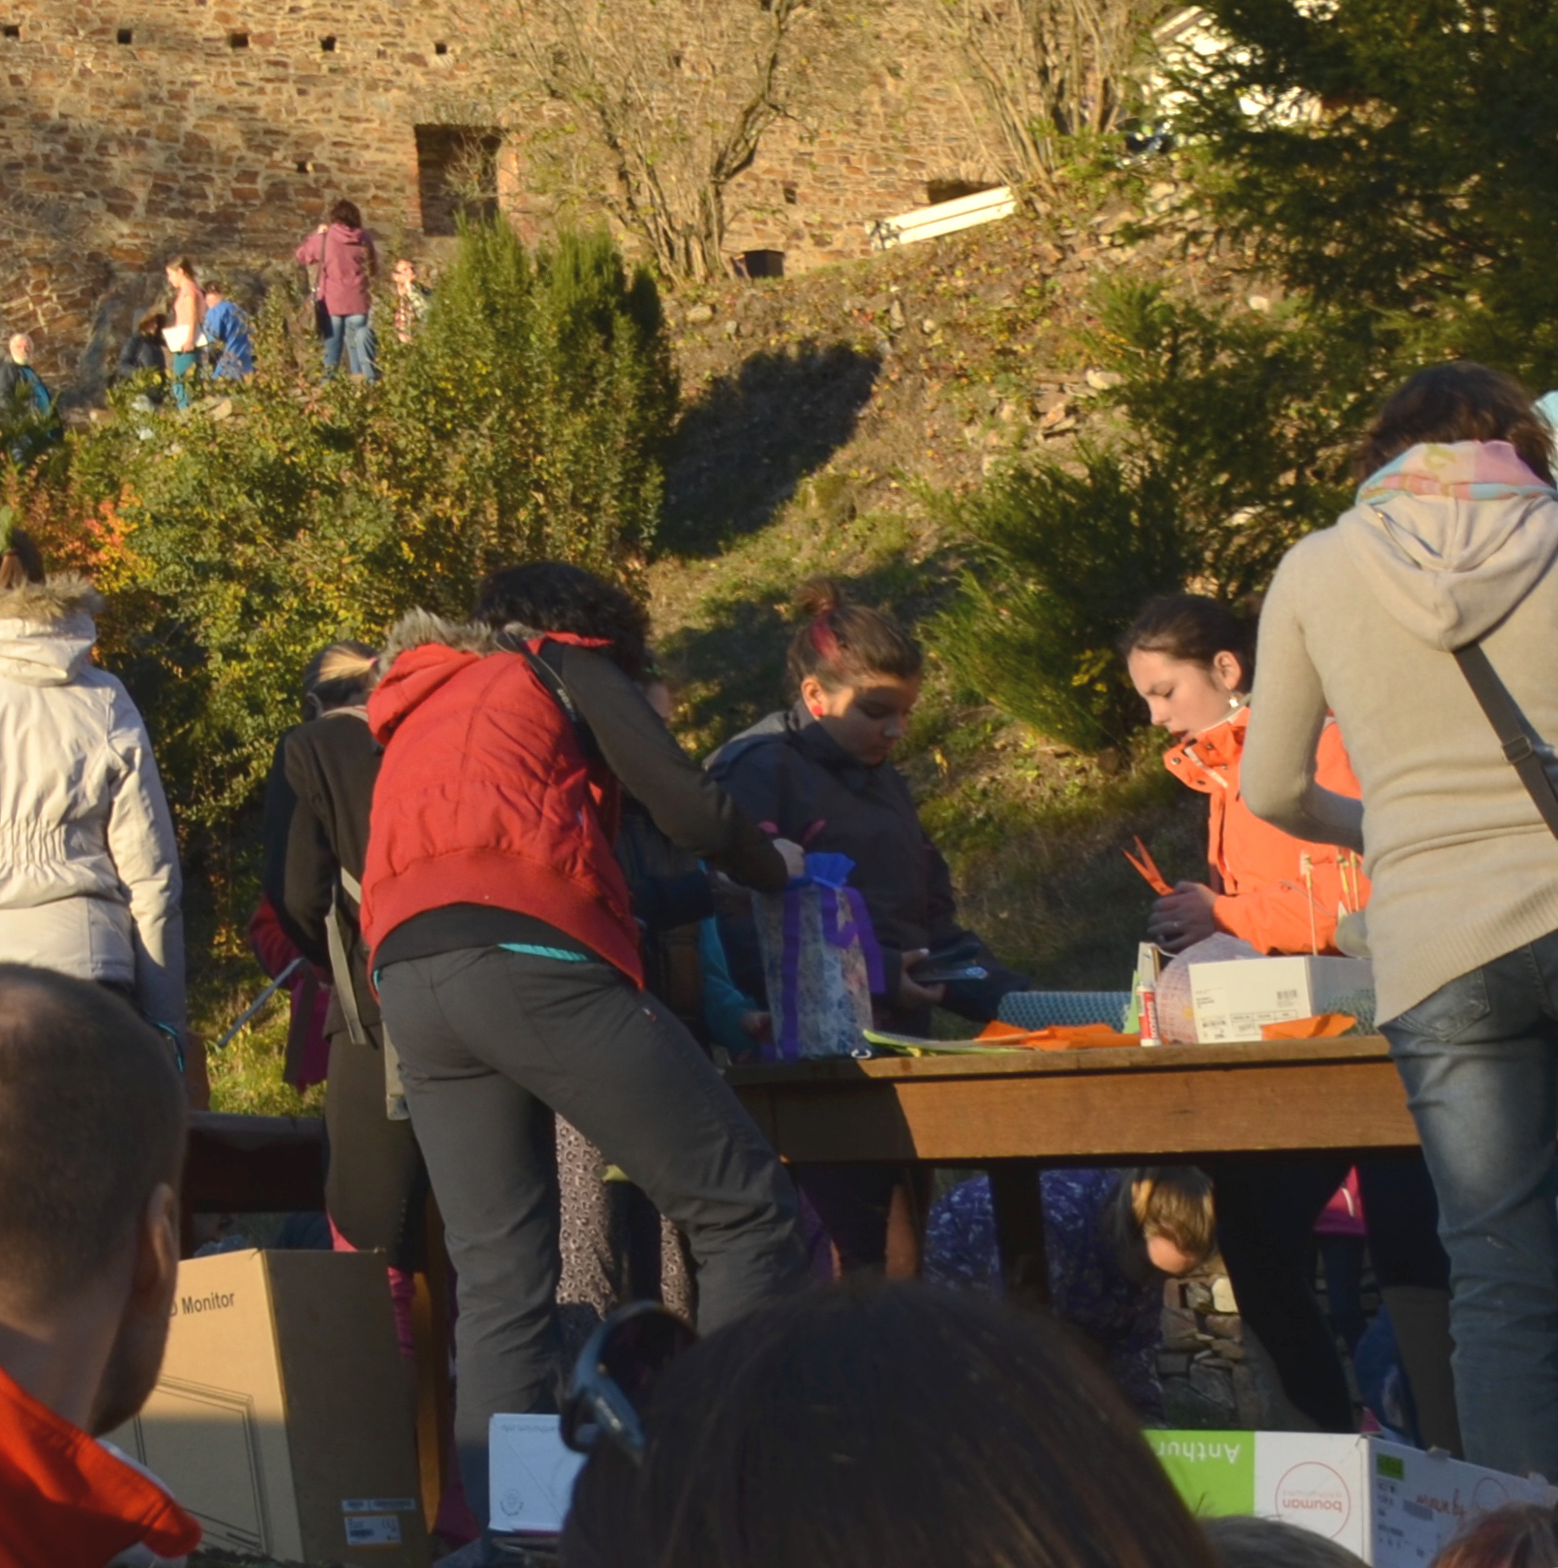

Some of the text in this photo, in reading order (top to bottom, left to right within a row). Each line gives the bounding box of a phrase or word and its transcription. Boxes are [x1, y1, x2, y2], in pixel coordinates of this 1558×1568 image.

[181, 1292, 234, 1314] Monitor
[1157, 1441, 1241, 1465] Anthur
[1282, 1498, 1342, 1513] bouman
